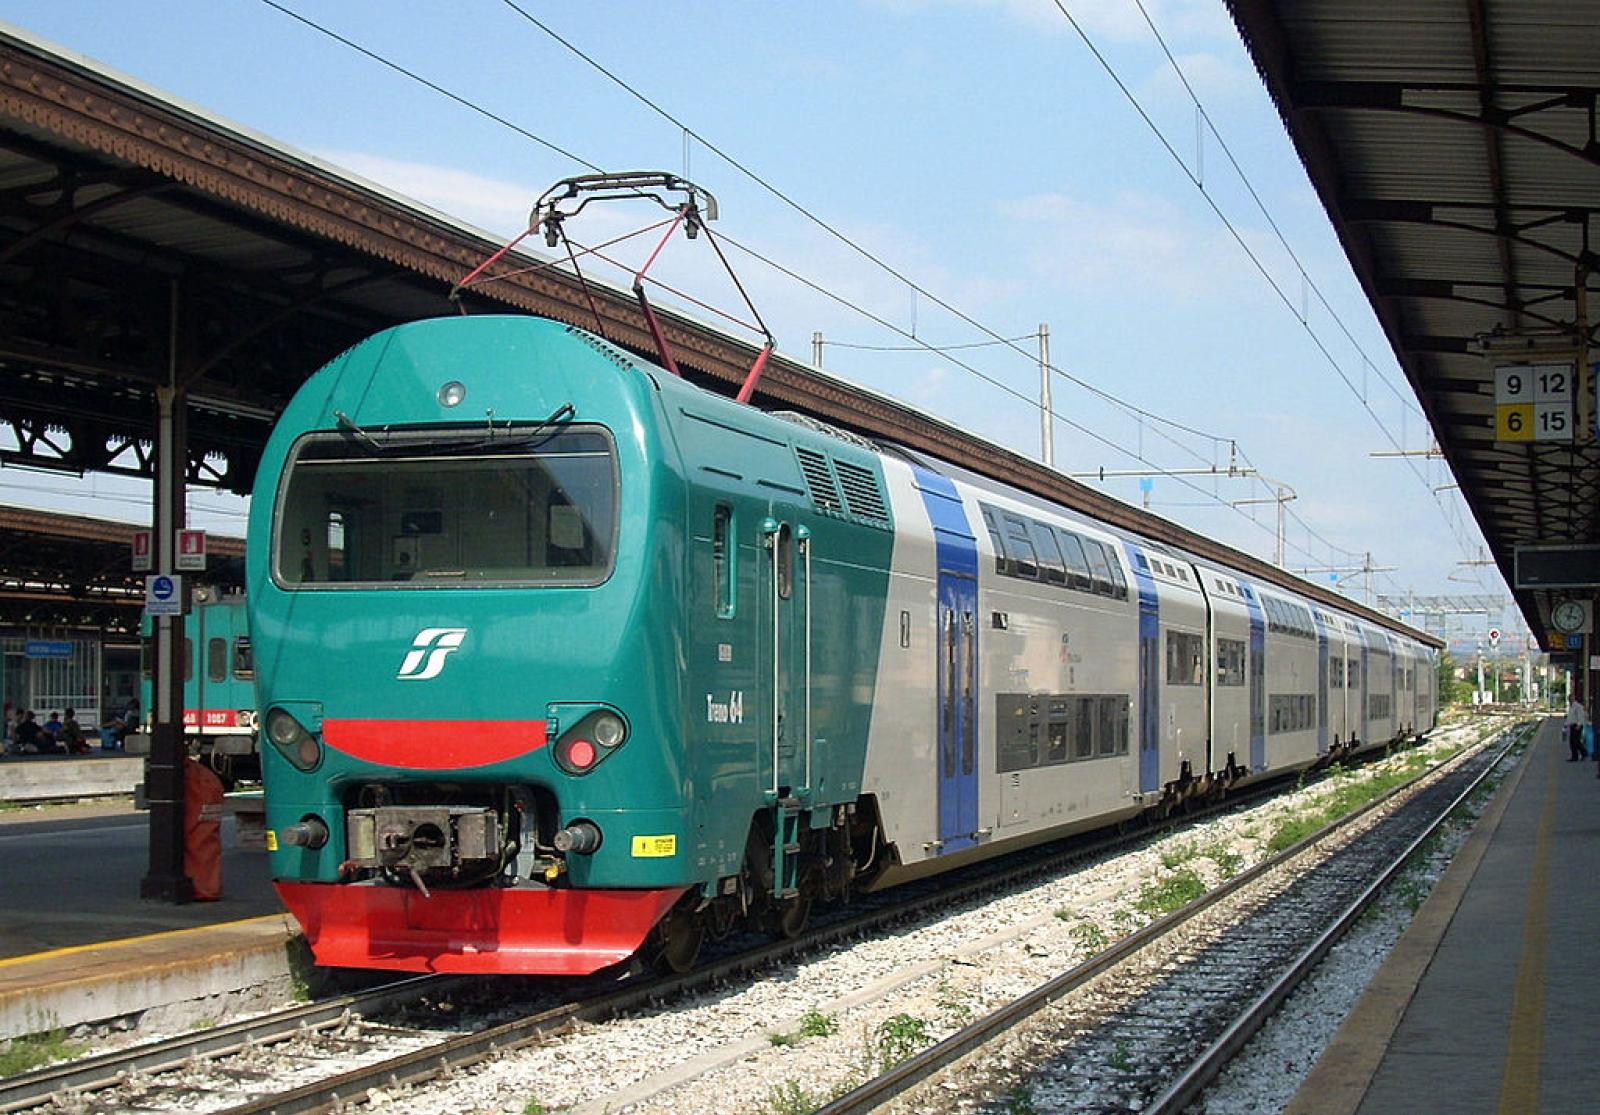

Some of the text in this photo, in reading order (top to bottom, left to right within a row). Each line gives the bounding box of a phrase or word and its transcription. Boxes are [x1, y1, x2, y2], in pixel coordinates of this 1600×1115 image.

[1507, 373, 1565, 394] 9 12
[1508, 412, 1566, 432] 6 15
[729, 691, 742, 723] 64
